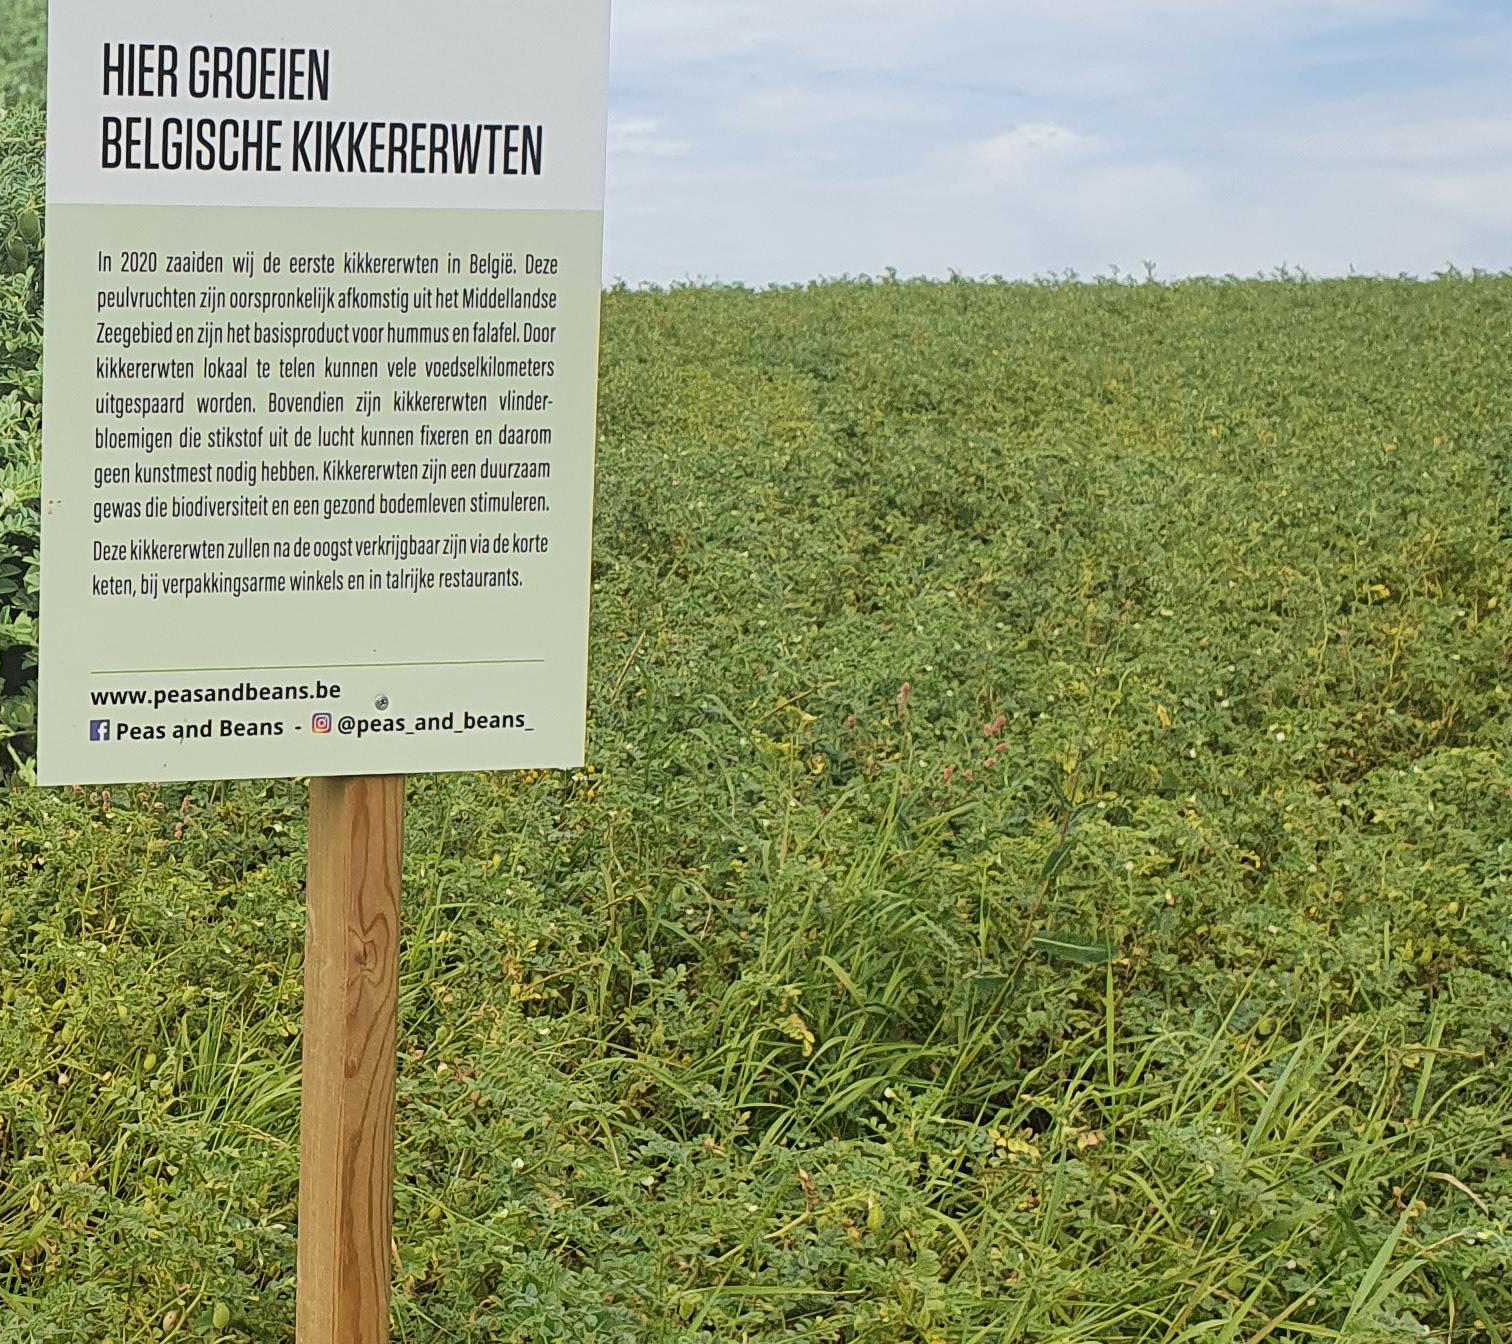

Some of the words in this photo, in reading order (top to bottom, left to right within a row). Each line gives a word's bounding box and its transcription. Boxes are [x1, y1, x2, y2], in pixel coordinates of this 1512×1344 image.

[102, 42, 178, 98] HIER
[189, 46, 330, 102] GROEIEN
[101, 116, 282, 172] BELGISCHE
[292, 120, 544, 176] KIKKERERWTEN
[98, 250, 112, 273] In
[120, 251, 157, 273] 2020
[165, 250, 223, 273] zaaiden
[232, 250, 255, 279] wij
[263, 251, 281, 274] de
[289, 253, 335, 274] eerste
[343, 251, 439, 274] kikkererwten
[447, 252, 461, 275] in
[469, 252, 517, 280] België.
[525, 253, 558, 275] Deze
[97, 285, 196, 313] peulvruchten
[199, 286, 226, 314] zijn
[229, 286, 335, 314] oorspronkelijk
[337, 286, 409, 314] afkomstig
[413, 286, 433, 309] uit
[435, 286, 460, 309] het
[462, 286, 557, 309] Middellandse
[96, 321, 173, 349] Zeegebied
[176, 326, 194, 344] en
[196, 321, 223, 349] zijn
[226, 321, 251, 344] het
[253, 321, 350, 348] basisproduct
[351, 326, 385, 345] voor
[386, 326, 450, 345] hummus
[452, 326, 470, 344] en
[472, 321, 520, 343] falafel.
[523, 322, 557, 343] Door
[96, 356, 194, 379] kikkererwten
[203, 356, 248, 379] lokaal
[255, 358, 271, 379] te
[279, 356, 315, 379] telen
[324, 355, 378, 378] kunnen
[387, 356, 417, 378] vele
[424, 355, 555, 378] voedselkilometers
[95, 391, 185, 419] uitgespaard
[196, 391, 256, 414] worden.
[268, 390, 344, 413] Bovendien
[355, 390, 381, 418] zijn
[393, 390, 487, 412] kikkererwten
[498, 389, 553, 411] vlinder-
[95, 426, 173, 454] bloemigen
[179, 426, 202, 449] die
[207, 425, 264, 448] stikstof
[269, 425, 289, 448] uit
[294, 425, 312, 448] de
[318, 425, 355, 447] lucht
[360, 424, 414, 447] kunnen
[419, 424, 469, 446] fixeren
[475, 428, 493, 446] en
[498, 423, 552, 445] daarom
[93, 467, 130, 489] geen
[134, 461, 213, 484] kunstmest
[216, 460, 257, 487] nodig
[261, 460, 319, 482] hebben.
[322, 459, 418, 481] Kikkererwten
[421, 458, 447, 485] zijn
[450, 463, 477, 480] een
[480, 457, 551, 479] duurzaam
[93, 501, 142, 524] gewas
[145, 495, 168, 518] die
[171, 494, 269, 518] biodiversiteit
[271, 499, 289, 516] en
[293, 499, 320, 516] een
[323, 492, 376, 520] gezond
[379, 492, 466, 514] bodemleven
[469, 490, 550, 513] stimuleren.
[93, 540, 127, 562] Deze
[130, 538, 225, 561] kikkererwten
[227, 537, 270, 559] zullen
[273, 541, 291, 558] na
[293, 536, 311, 558] de
[313, 537, 353, 562] oogst
[355, 534, 441, 561] verkrijgbaar
[442, 533, 467, 560] zijn
[469, 532, 490, 554] via
[492, 532, 510, 554] de
[512, 532, 549, 553] korte
[92, 574, 137, 598] keten,
[140, 572, 158, 600] bij
[161, 571, 286, 599] verpakkingsarme
[289, 569, 344, 592] winkels
[347, 574, 365, 591] en
[369, 568, 382, 590] in
[385, 567, 435, 594] talrijke
[438, 567, 523, 589] restaurants.
[90, 680, 341, 710] www.peasandbeans.be
[116, 722, 166, 741] Peas
[172, 719, 215, 740] and
[219, 719, 284, 738] Beans
[337, 710, 535, 739] @peas_and_beans_
